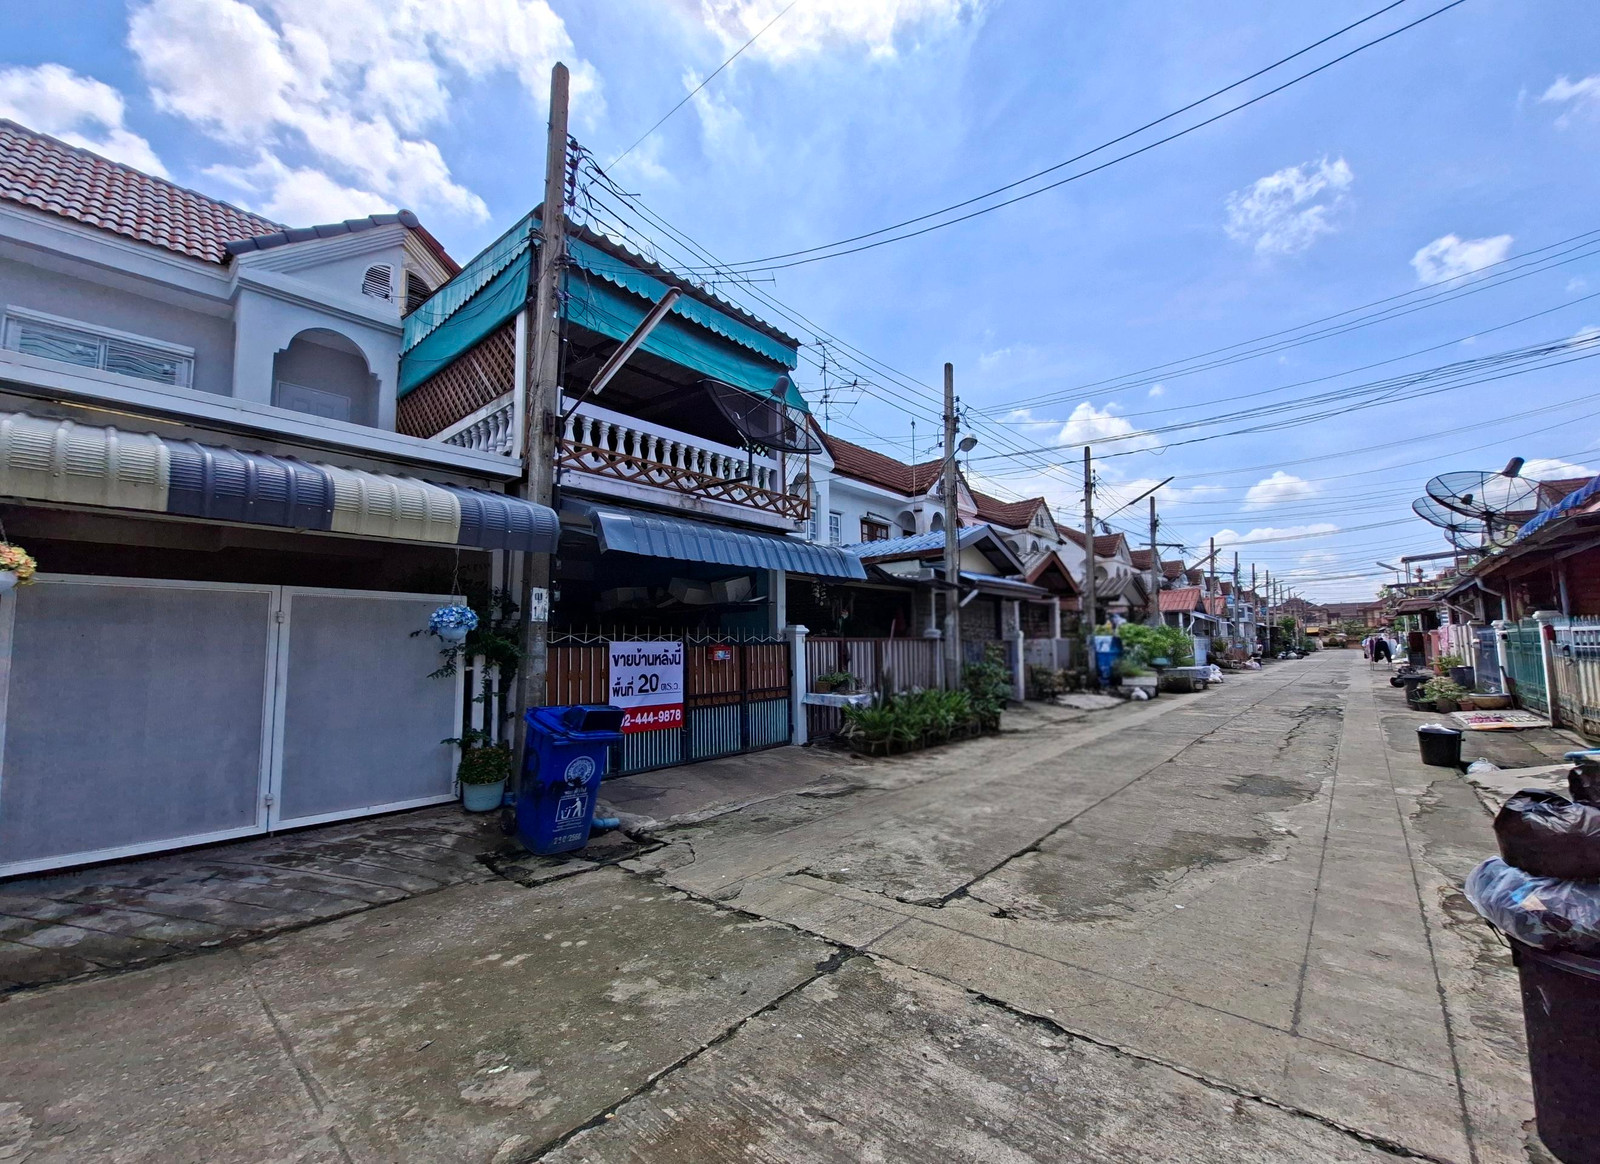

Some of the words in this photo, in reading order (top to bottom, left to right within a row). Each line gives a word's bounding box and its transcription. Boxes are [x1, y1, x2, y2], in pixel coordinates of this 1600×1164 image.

[612, 643, 682, 667] ขายบ้านหลังนี้
[612, 676, 634, 697] พื้นที่
[637, 673, 660, 694] 20
